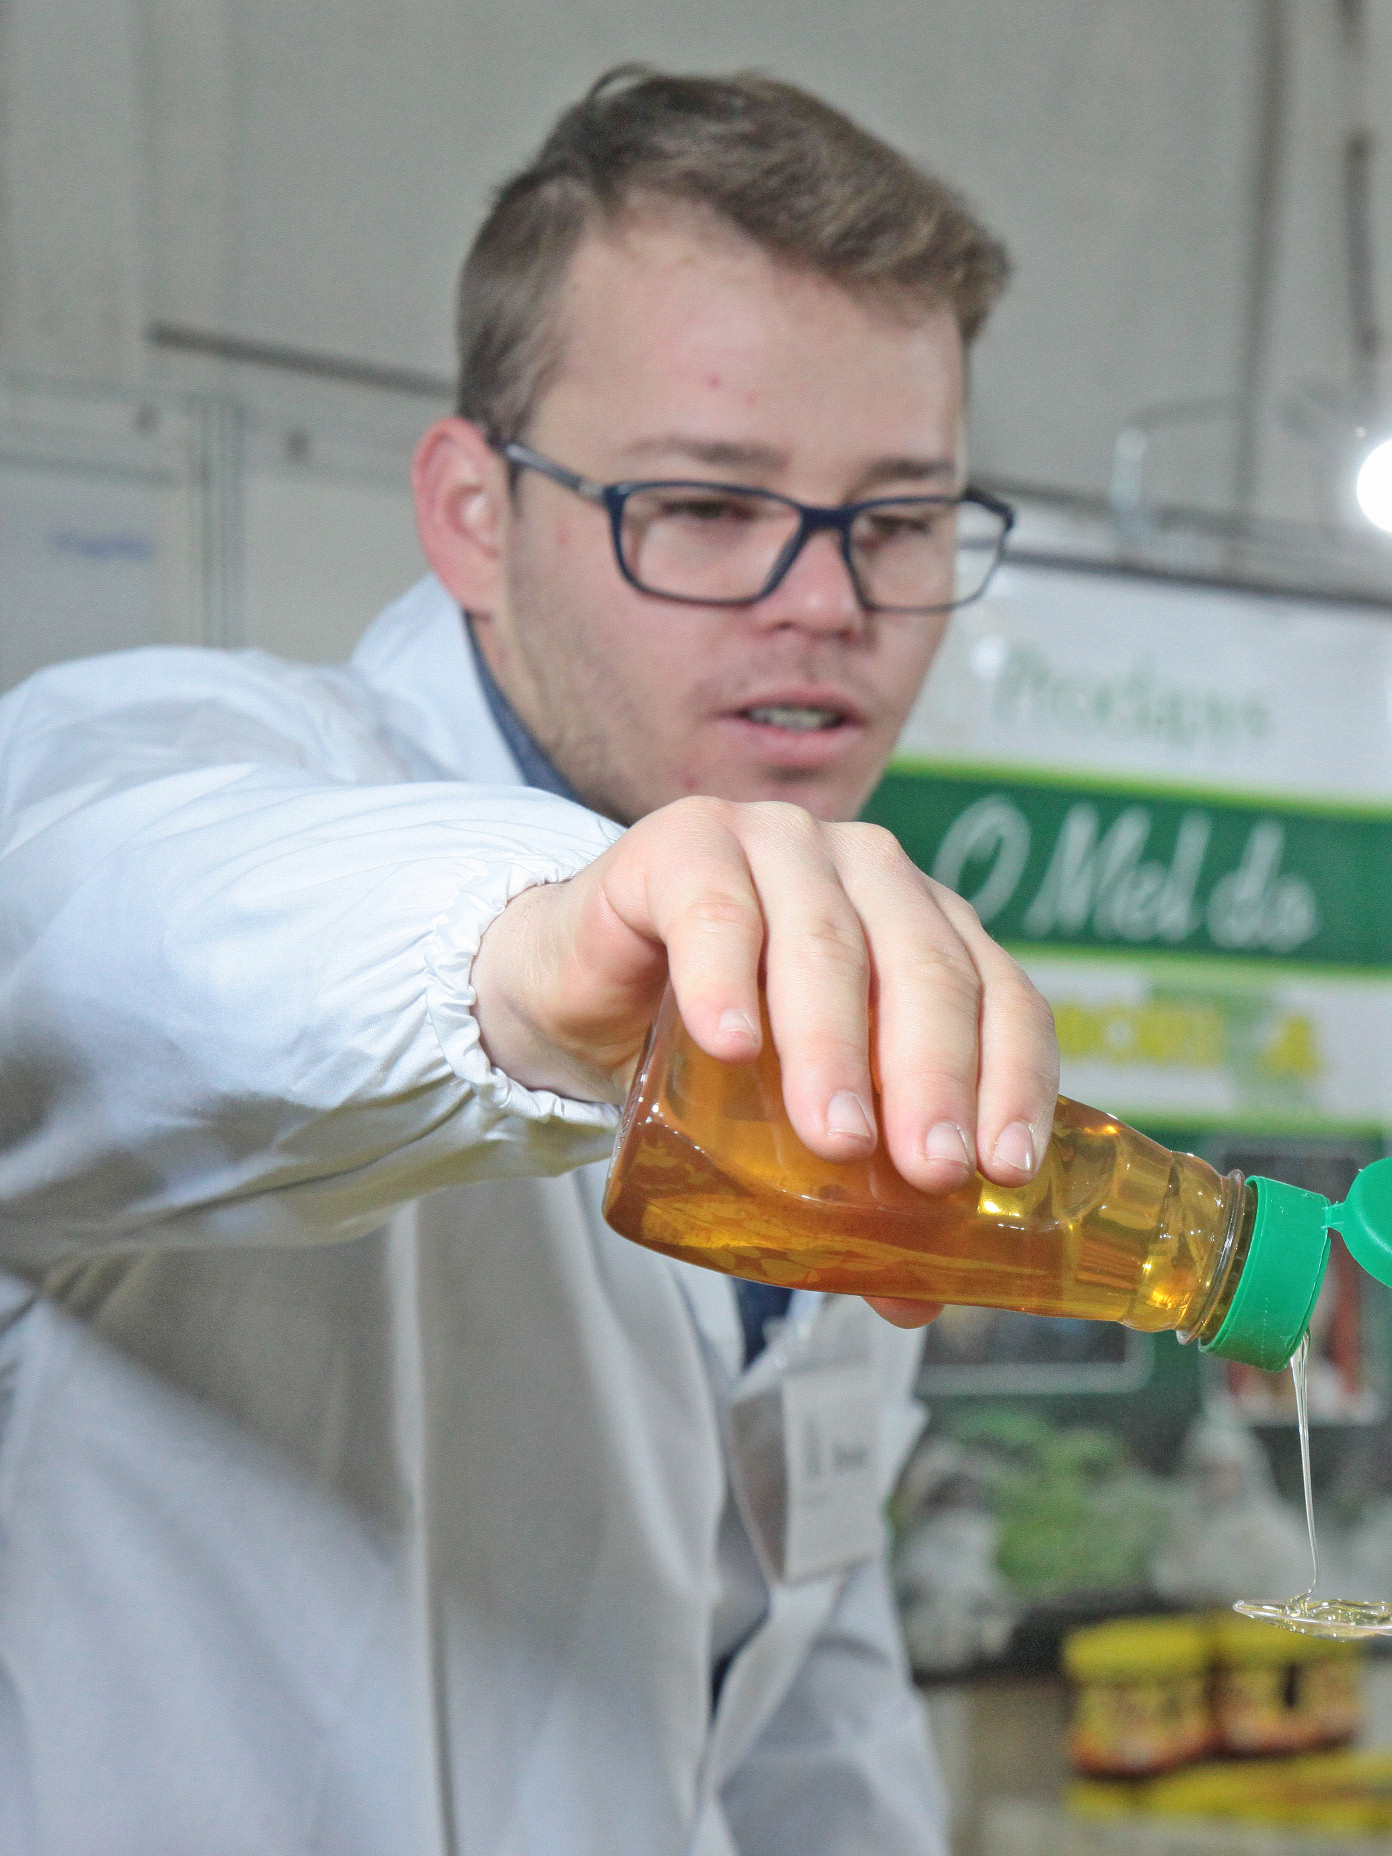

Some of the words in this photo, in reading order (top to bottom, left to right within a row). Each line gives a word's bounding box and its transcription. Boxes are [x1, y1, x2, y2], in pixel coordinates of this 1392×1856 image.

[931, 795, 1031, 927] O
[1021, 802, 1212, 945] Mel
[1206, 818, 1317, 953] do
